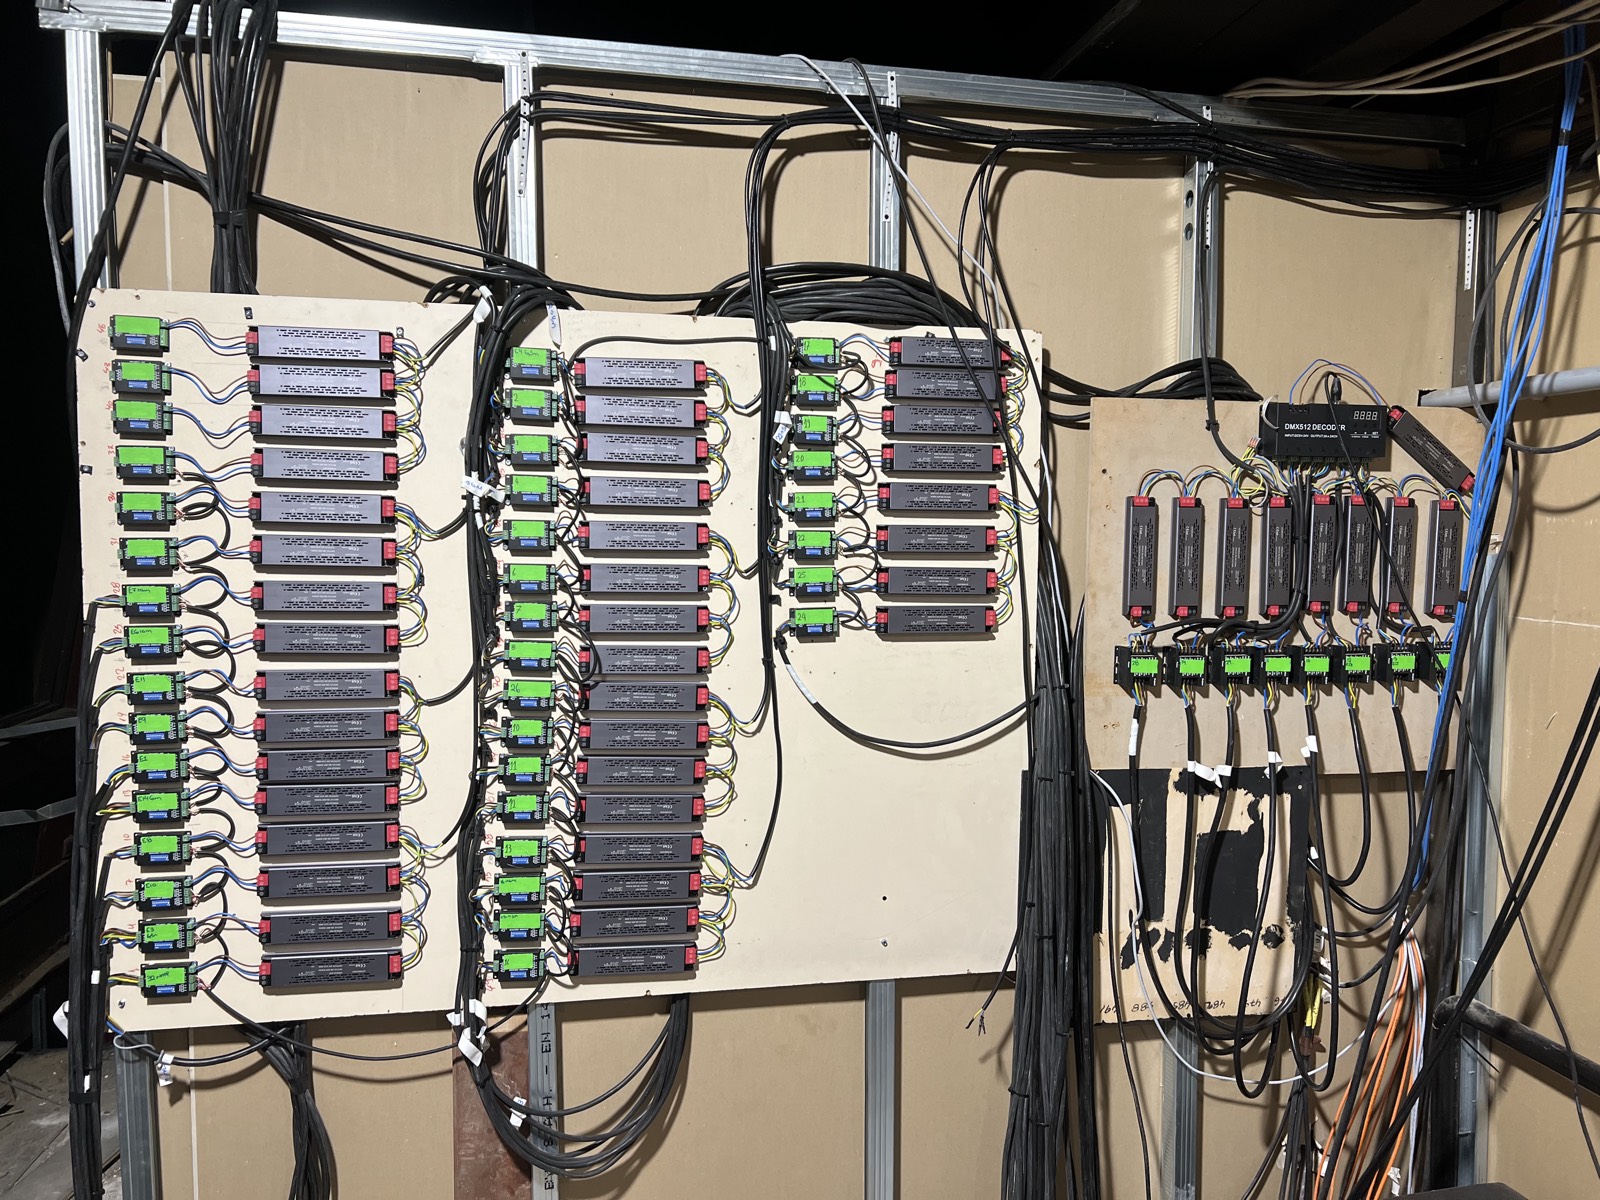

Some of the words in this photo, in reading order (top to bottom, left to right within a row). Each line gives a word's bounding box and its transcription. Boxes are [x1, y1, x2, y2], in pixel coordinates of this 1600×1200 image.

[799, 376, 806, 388] 18
[796, 495, 806, 503] 21
[515, 605, 522, 614] 7
[510, 683, 521, 694] 26
[512, 723, 520, 732] 10
[541, 1032, 552, 1054] EN
